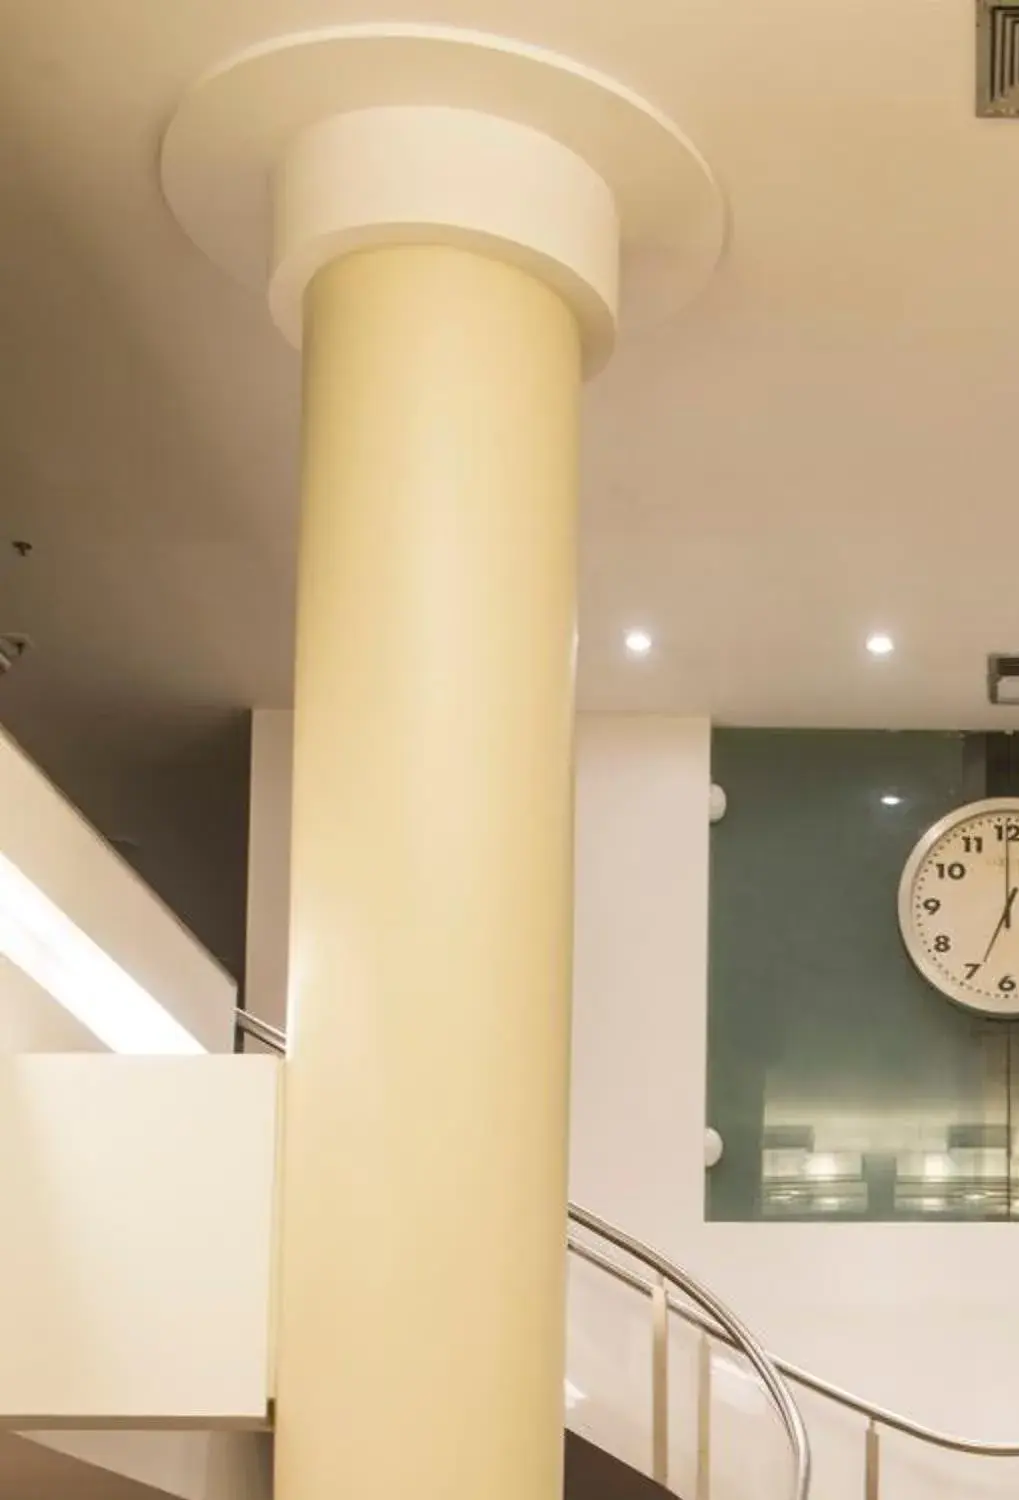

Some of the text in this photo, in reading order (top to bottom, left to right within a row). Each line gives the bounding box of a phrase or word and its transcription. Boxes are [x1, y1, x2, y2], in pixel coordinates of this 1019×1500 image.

[962, 836, 983, 853] 11
[936, 862, 966, 880] 10
[923, 898, 941, 915] 9
[933, 935, 951, 953] 8
[964, 963, 981, 980] 7
[998, 975, 1016, 992] 6
